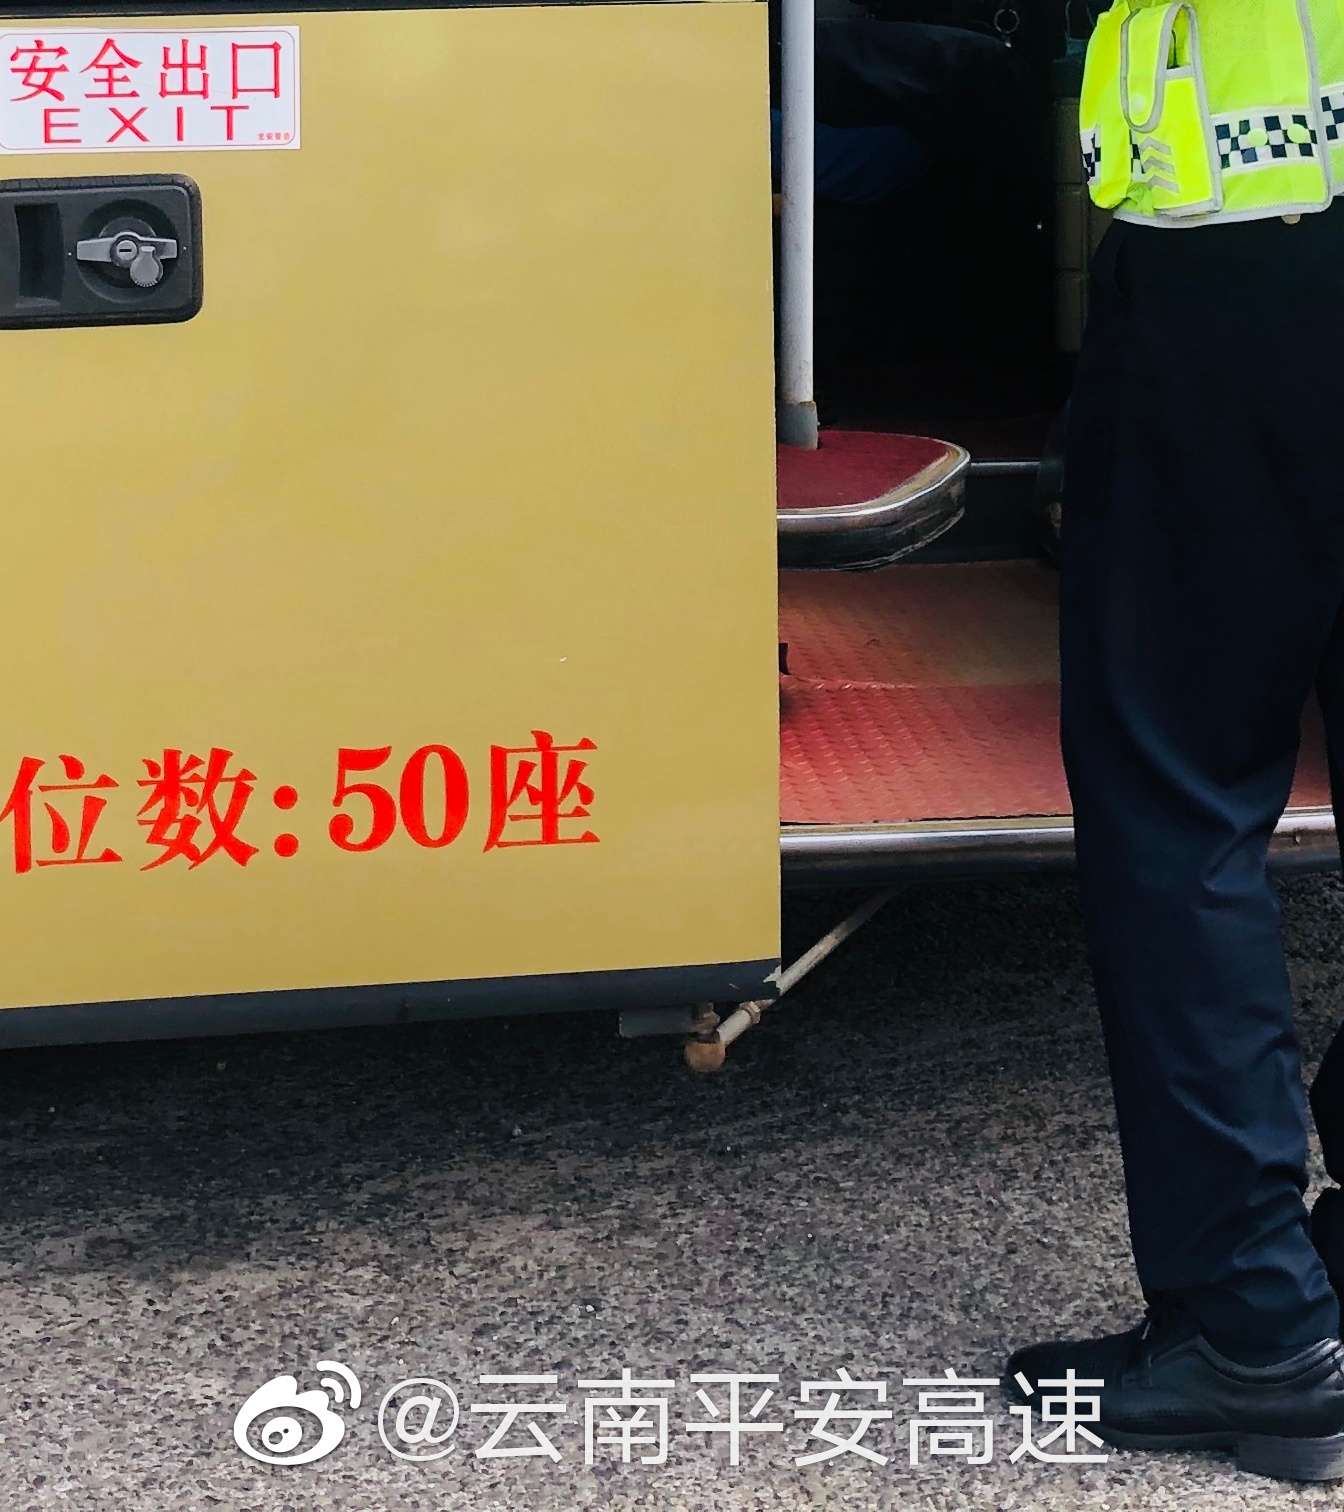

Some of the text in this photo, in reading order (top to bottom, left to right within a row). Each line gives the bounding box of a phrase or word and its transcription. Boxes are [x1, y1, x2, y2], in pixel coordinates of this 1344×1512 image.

[10, 38, 283, 102] 安全出口
[43, 105, 250, 144] EXIT
